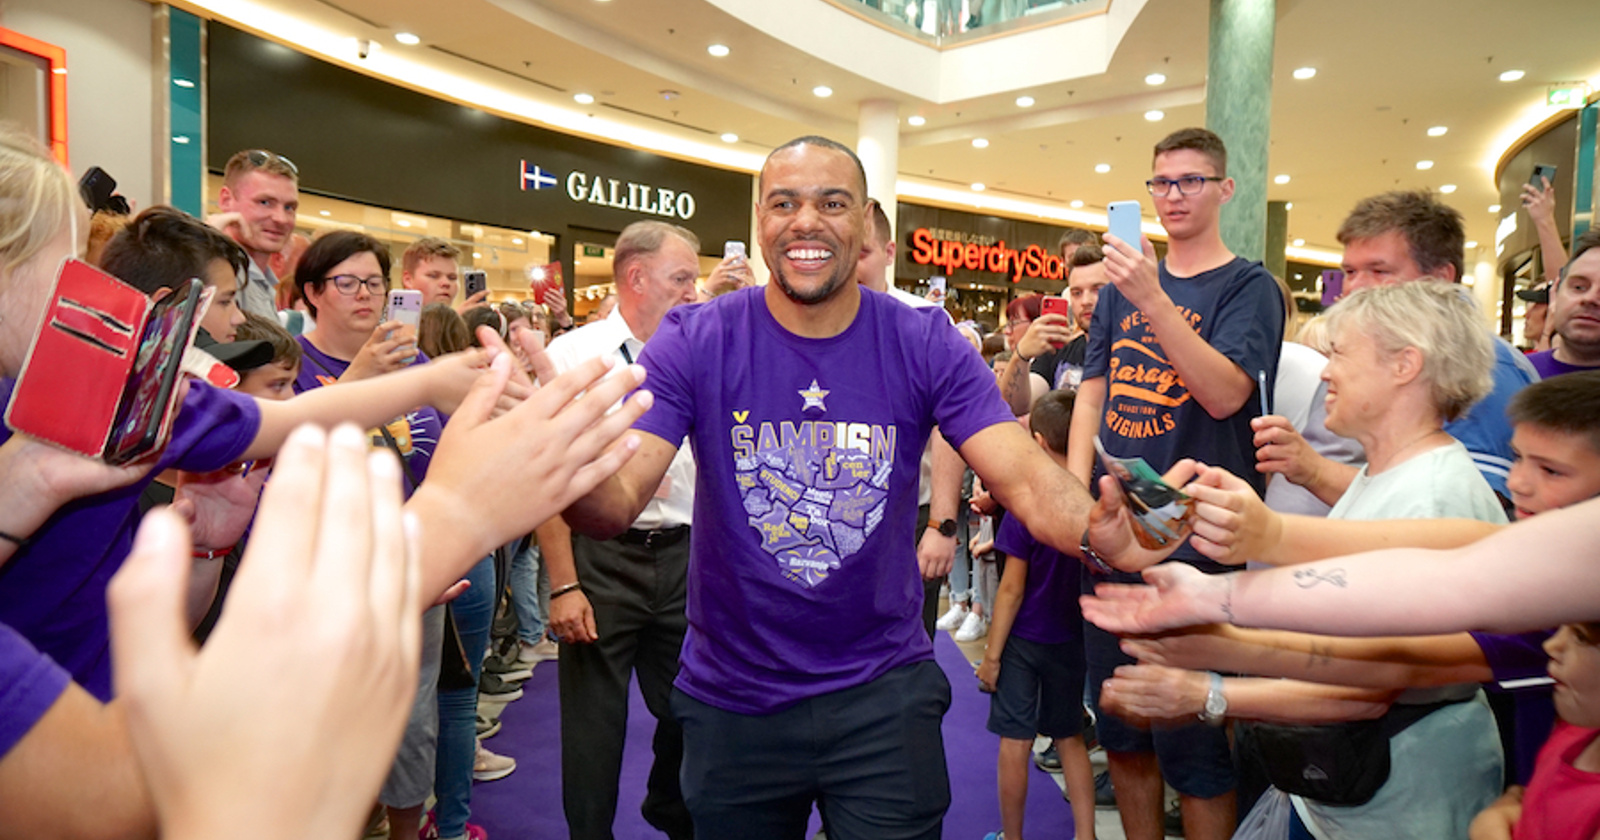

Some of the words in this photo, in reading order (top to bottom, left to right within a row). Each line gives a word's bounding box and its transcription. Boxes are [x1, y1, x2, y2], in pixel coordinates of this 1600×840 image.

[567, 171, 696, 219] GALILEO
[912, 228, 1069, 283] SuperdryStor
[1105, 409, 1176, 438] RIGINALS
